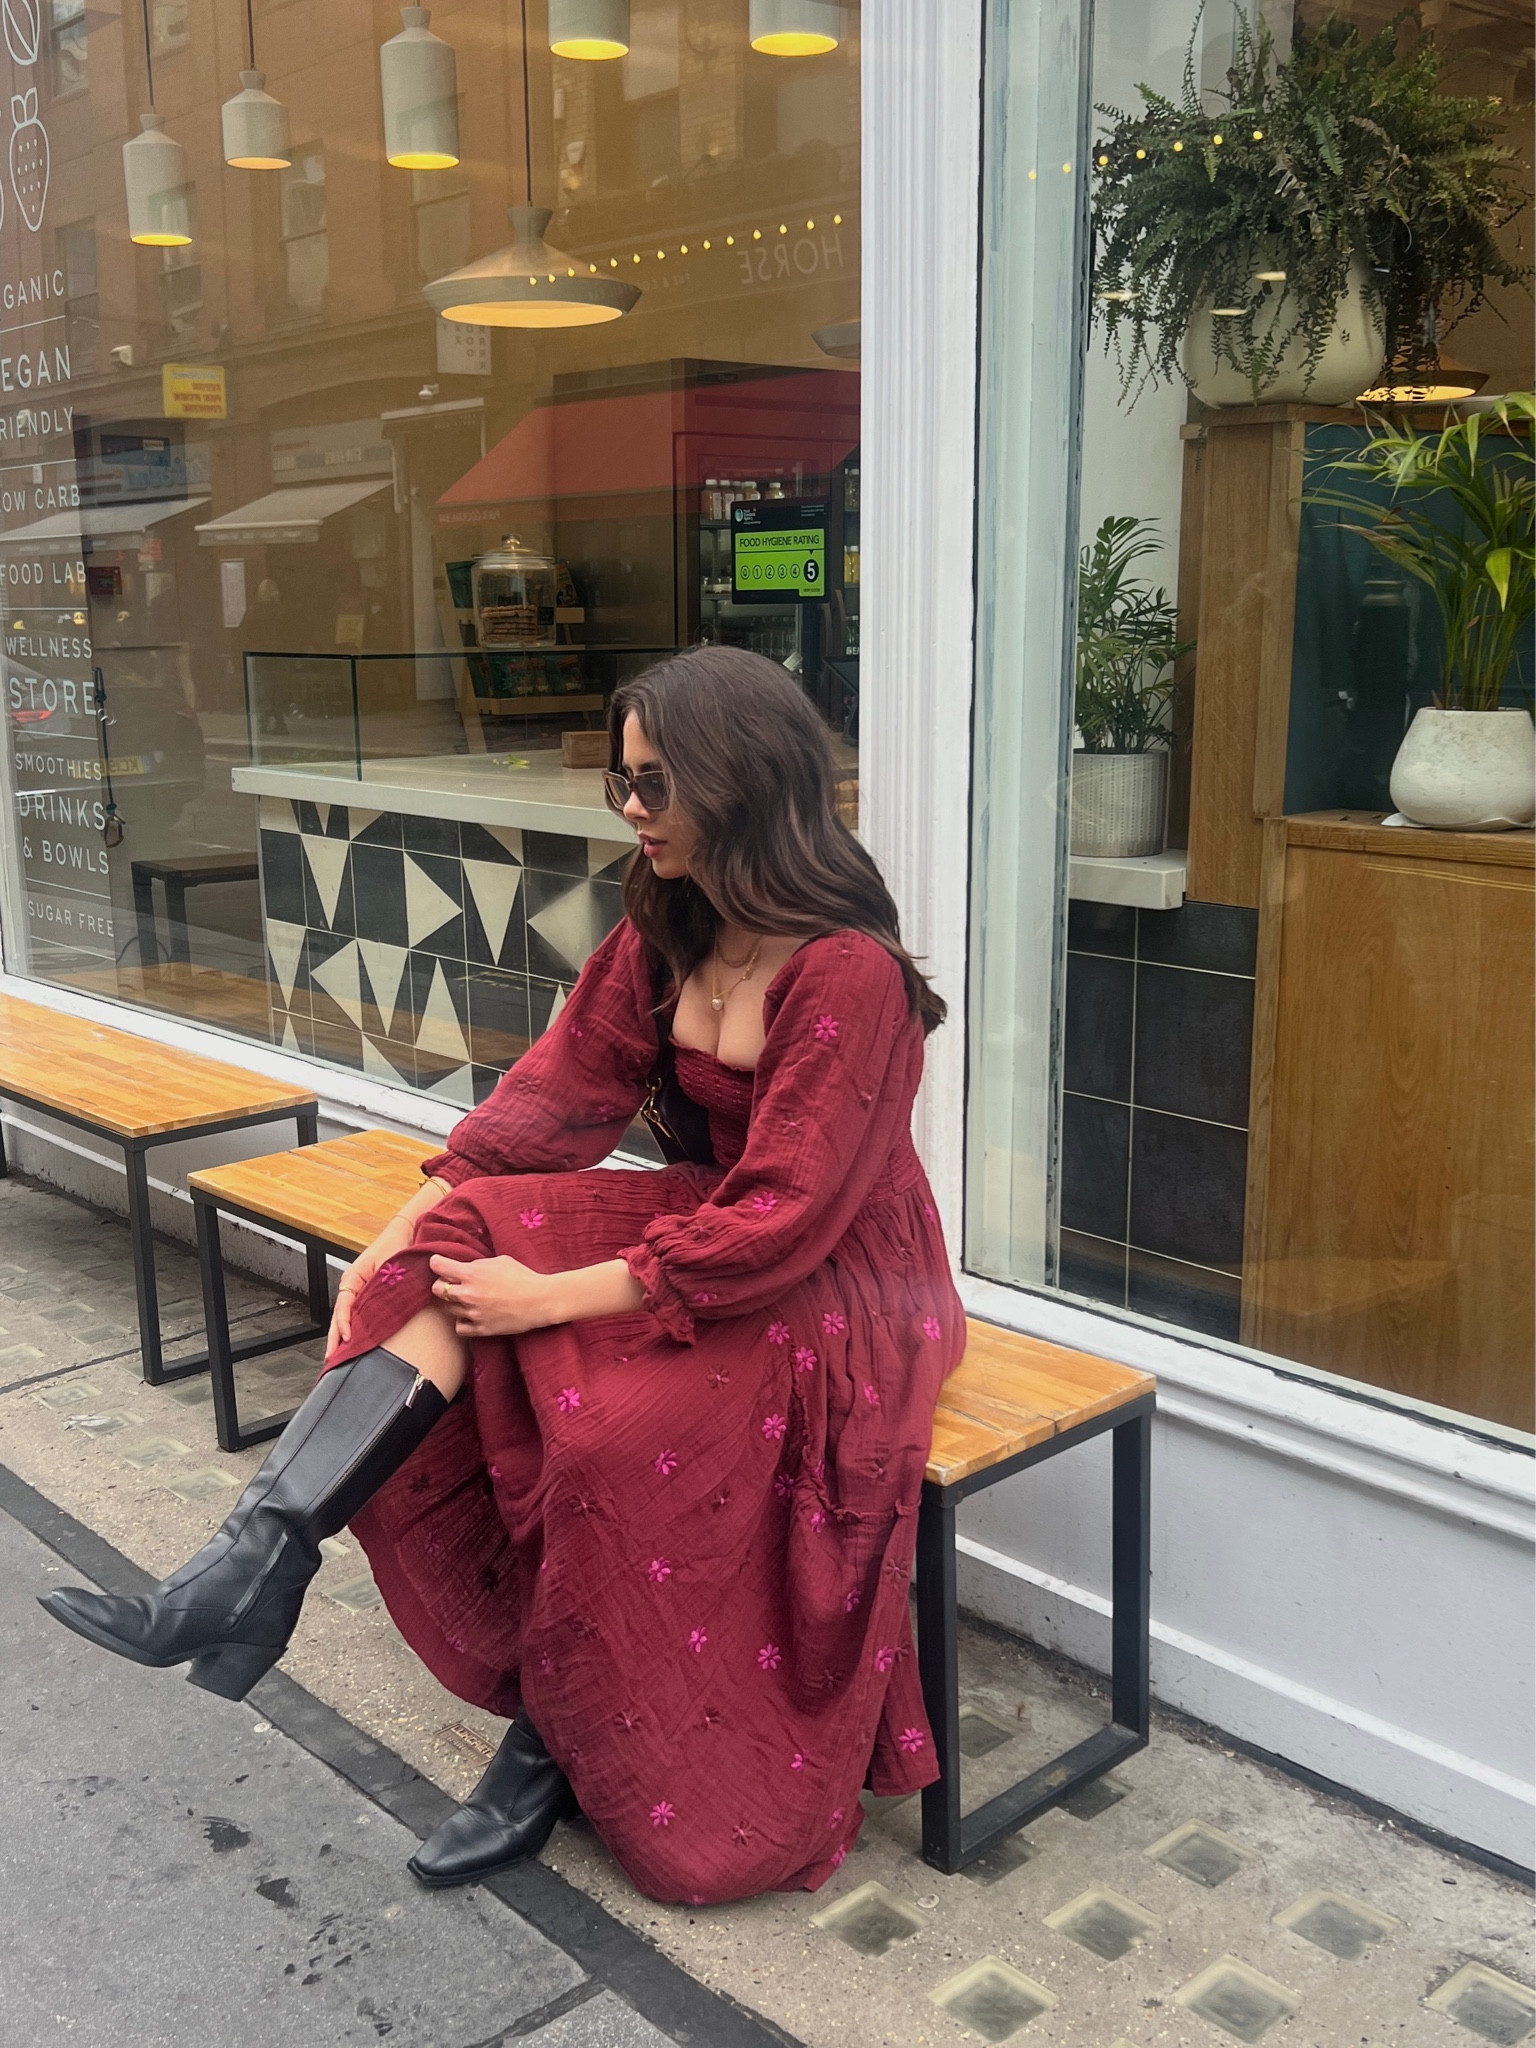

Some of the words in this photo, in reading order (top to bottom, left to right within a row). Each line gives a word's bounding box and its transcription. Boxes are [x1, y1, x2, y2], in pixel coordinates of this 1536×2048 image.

[0, 270, 65, 311] GANIC
[1, 345, 71, 392] EGAN
[0, 406, 74, 441] RIENDLY
[0, 490, 26, 512] OW
[35, 484, 81, 510] CARB
[740, 538, 760, 547] FOOD
[762, 536, 792, 546] HYGIENE
[793, 534, 820, 545] RATING
[0, 562, 44, 585] FOOD
[52, 561, 87, 584] LAB
[807, 562, 816, 580] 5
[6, 636, 93, 659] WELLNESS
[9, 677, 96, 715] STORE
[15, 753, 102, 781] SMOOTHIES
[19, 795, 106, 831] DRINKS
[23, 836, 33, 859] &
[42, 840, 109, 875] BOWLS
[28, 900, 73, 926] SUGAR
[79, 912, 115, 938] FREE
